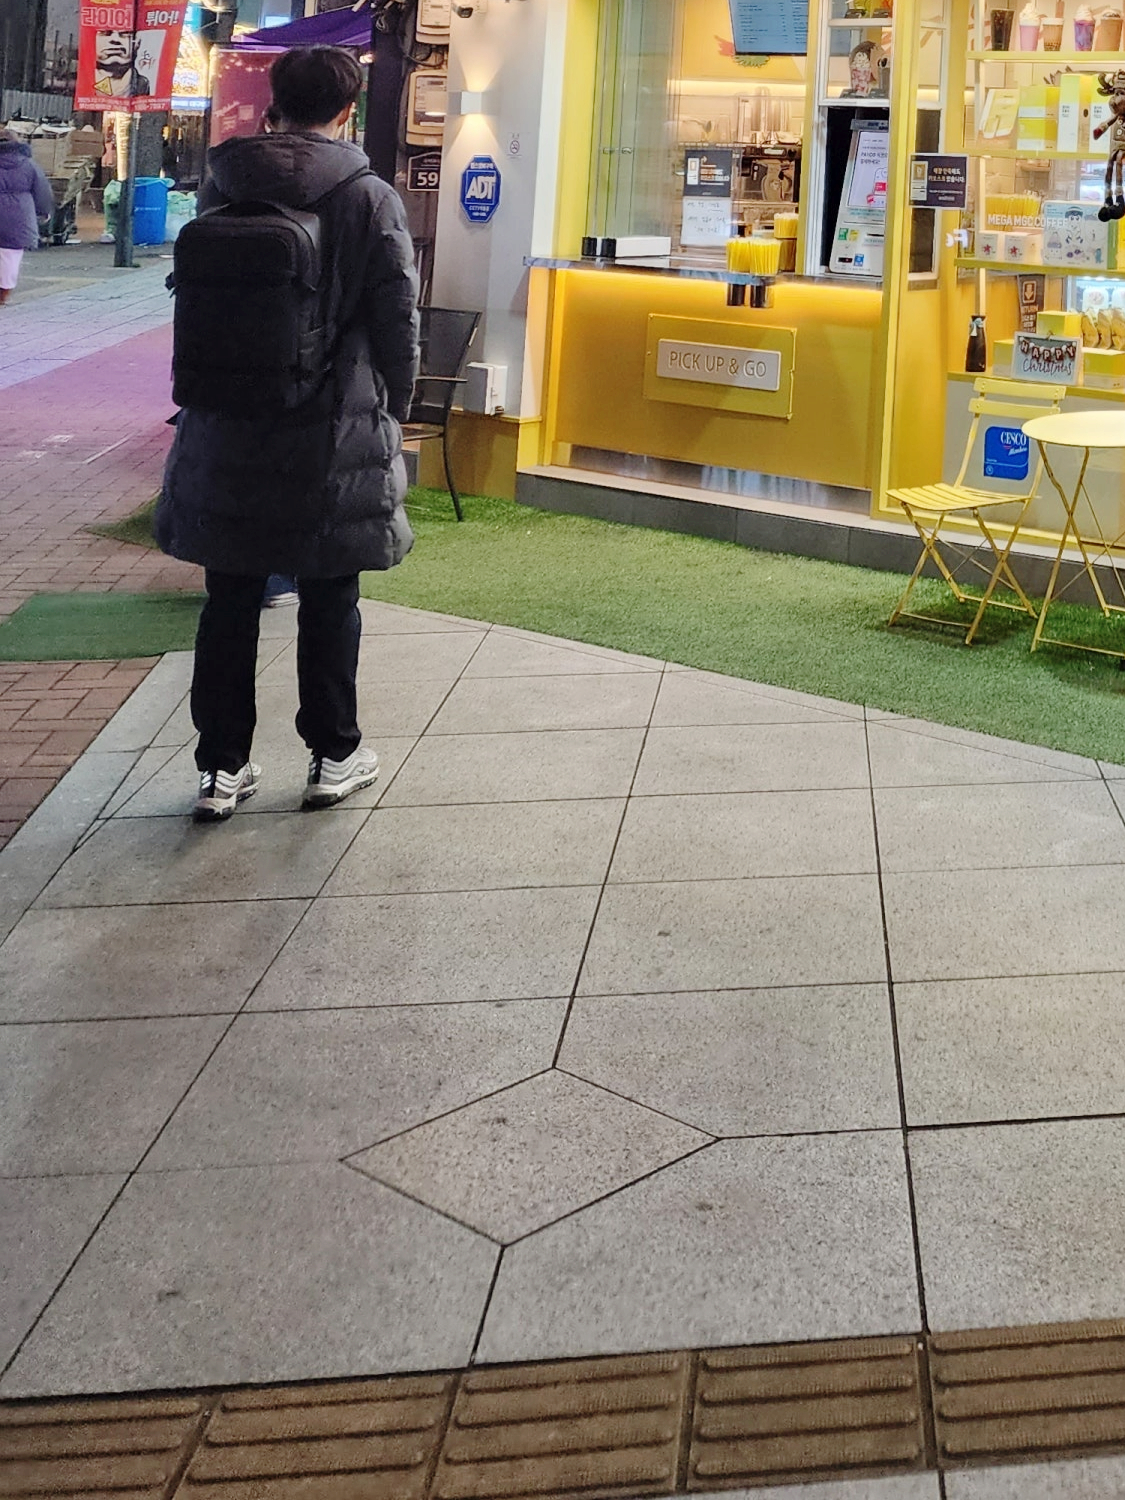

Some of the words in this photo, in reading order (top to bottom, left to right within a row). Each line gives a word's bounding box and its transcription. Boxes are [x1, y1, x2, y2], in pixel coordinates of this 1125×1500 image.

[416, 171, 439, 187] 59
[465, 175, 497, 199] ADT
[987, 213, 1013, 227] MEGA
[1013, 214, 1034, 227] MGC
[1020, 340, 1077, 363] HAPPY
[669, 350, 701, 372] PICK
[704, 355, 725, 373] UP
[728, 358, 740, 376] &
[744, 360, 767, 378] GO
[1022, 358, 1072, 376] Christmas
[1000, 430, 1027, 446] CESCO
